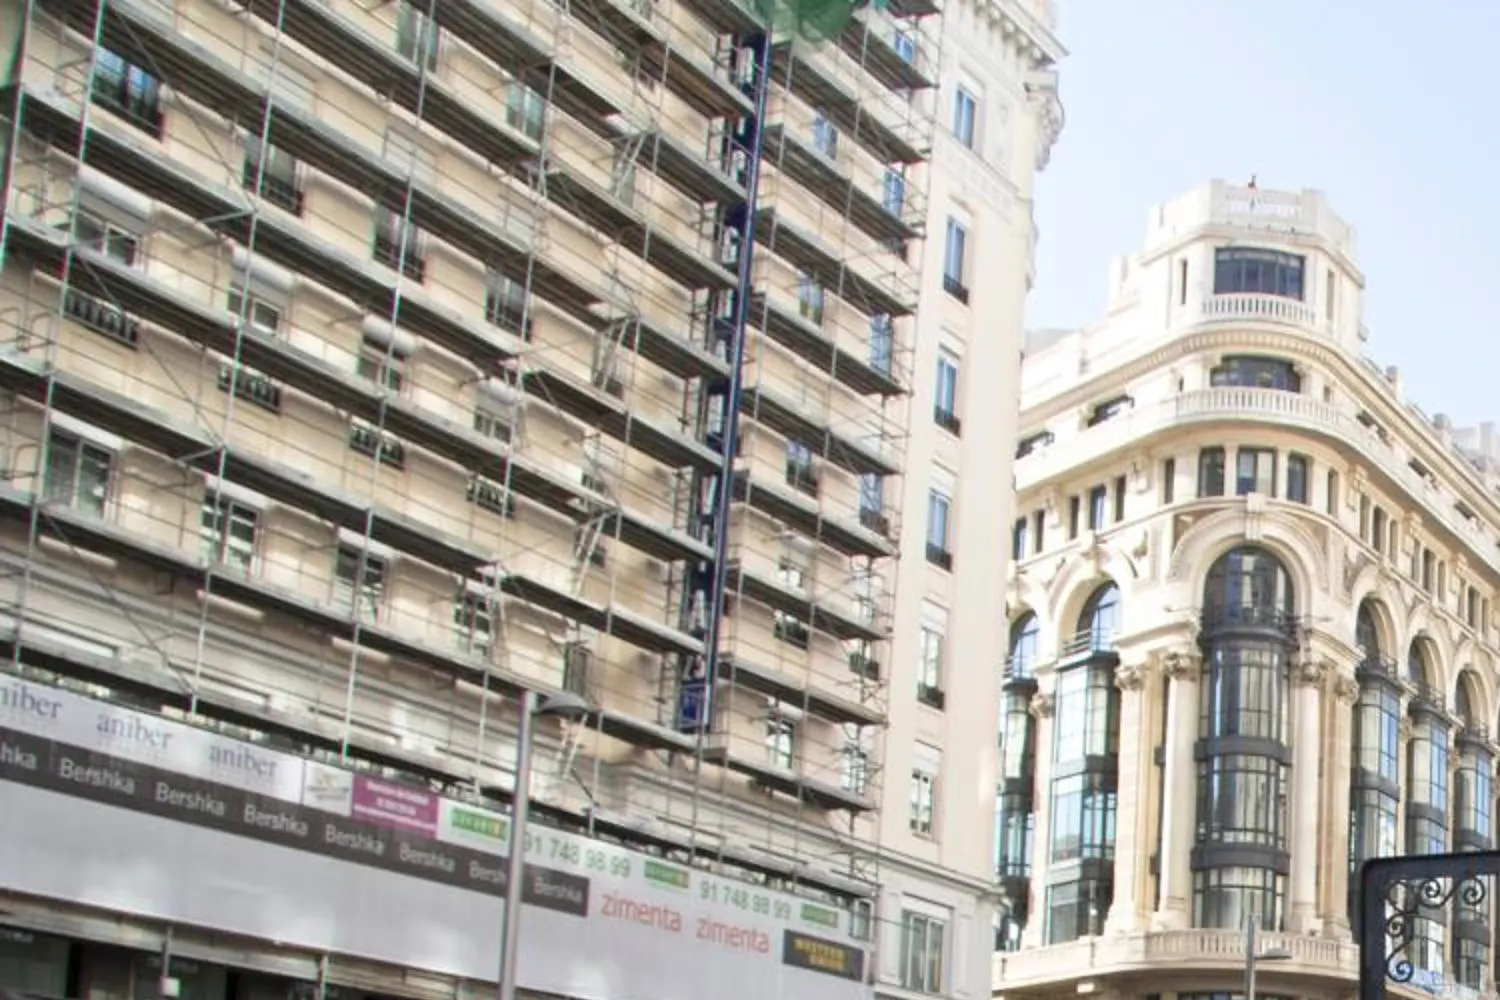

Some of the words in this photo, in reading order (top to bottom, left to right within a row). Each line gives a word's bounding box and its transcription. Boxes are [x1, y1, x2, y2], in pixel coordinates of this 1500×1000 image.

[60, 757, 135, 795] Bershka
[155, 782, 225, 816] Bershka
[244, 804, 308, 837] Bershka
[325, 824, 385, 856] Bershka
[400, 843, 456, 873] Bershka
[469, 861, 506, 883] Bersh
[534, 877, 583, 903] Bershka
[601, 891, 682, 933] zimenta
[696, 915, 770, 954] zimenta
